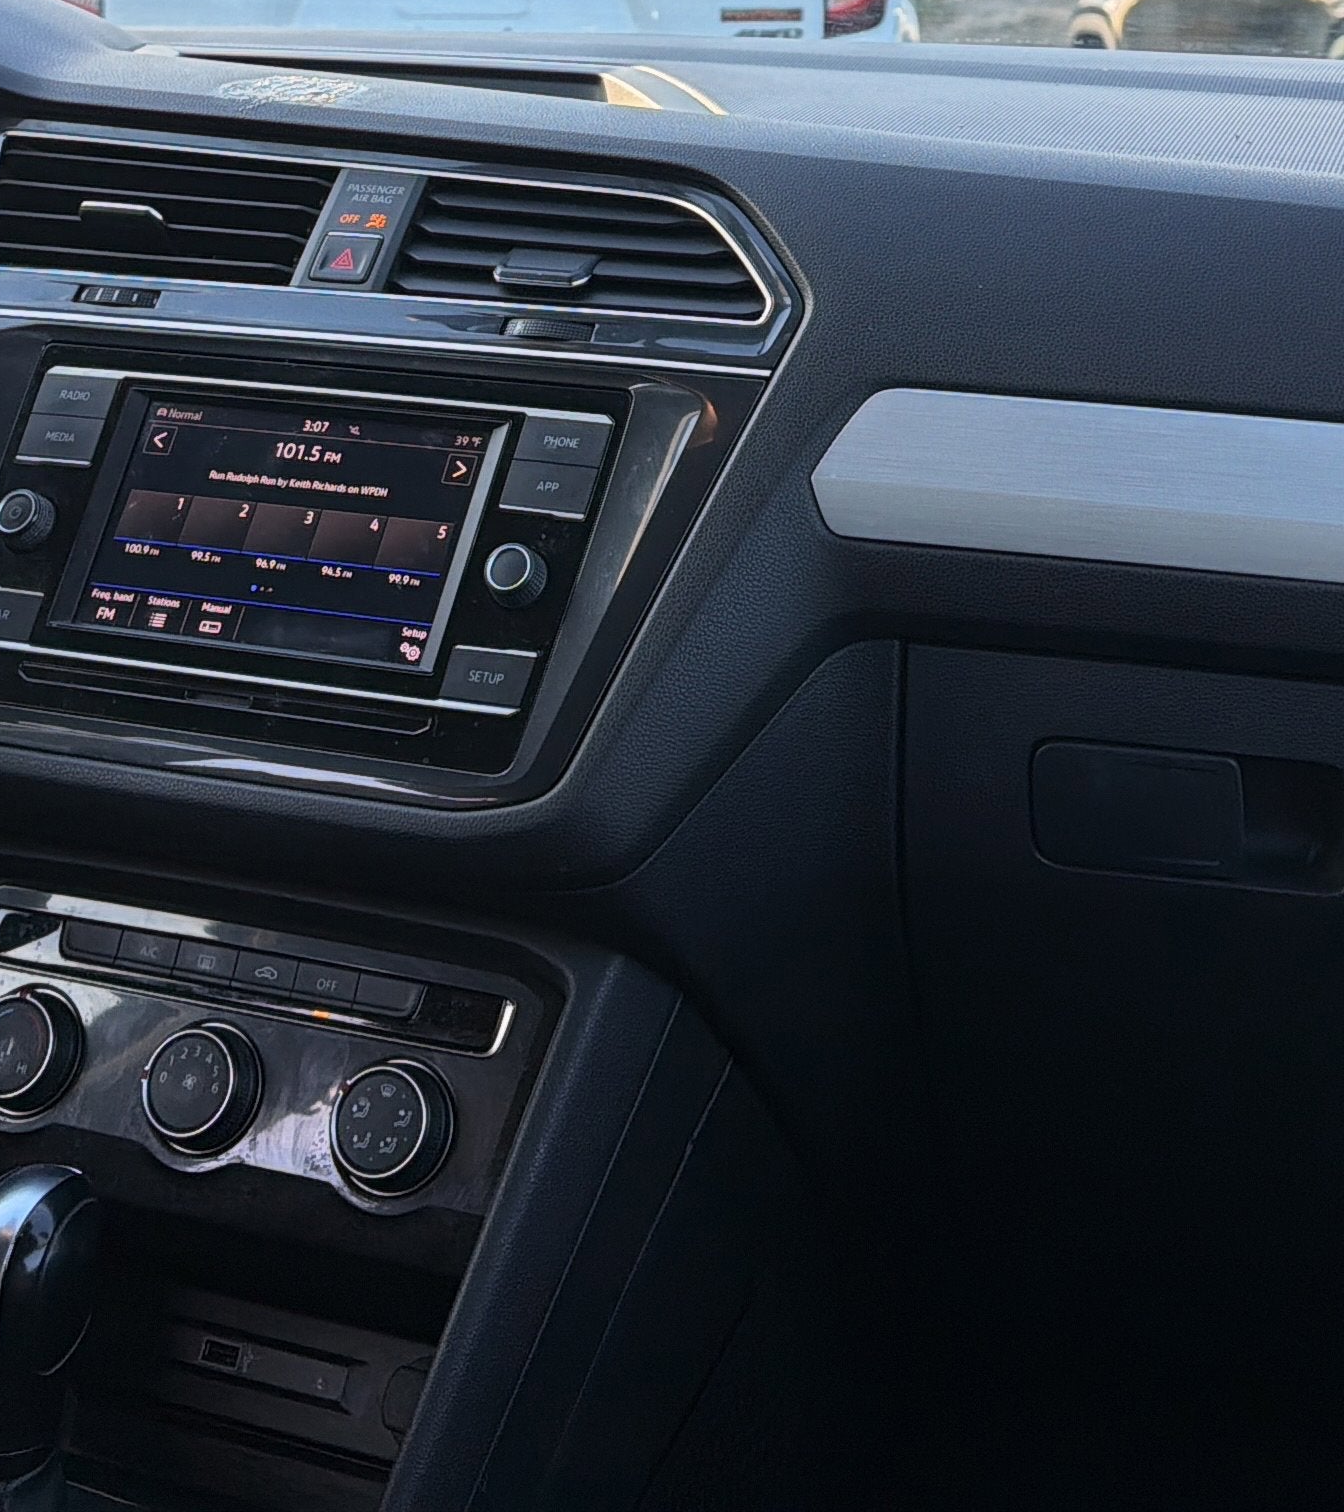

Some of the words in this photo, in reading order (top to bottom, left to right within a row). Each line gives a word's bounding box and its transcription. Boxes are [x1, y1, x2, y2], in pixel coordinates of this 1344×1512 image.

[347, 183, 406, 195] PASSENGER
[351, 193, 368, 203] AIR
[370, 194, 394, 205] BAG
[339, 213, 362, 225] OFF
[59, 389, 91, 402] RADIO
[168, 407, 204, 422] Normal
[302, 419, 331, 433] 3:07
[44, 430, 76, 443] MEDIA
[454, 435, 469, 447] 39
[543, 434, 580, 449] PHONE
[274, 441, 324, 462] 101.5
[323, 450, 342, 464] FM
[208, 470, 226, 481] Run
[226, 471, 259, 485] Rudolph
[260, 475, 277, 486] Run
[277, 477, 289, 489] by
[289, 478, 311, 490] Keith
[312, 481, 347, 494] Richards
[347, 485, 359, 494] on
[360, 486, 389, 498] WPDH
[536, 480, 560, 492] APP
[177, 497, 185, 510] 1
[239, 504, 250, 518] 2
[304, 511, 314, 525] 3
[369, 518, 380, 532] 4
[437, 525, 448, 540] 5
[124, 543, 149, 555] 100.9
[191, 551, 210, 563] 99.5
[388, 573, 410, 585] 99.9
[113, 591, 135, 603] band
[147, 596, 181, 609] Stations
[95, 606, 117, 621] FM
[201, 602, 233, 615] Manual
[401, 626, 428, 641] Setup
[467, 669, 505, 686] SETUP
[140, 945, 159, 957] A/C
[316, 977, 338, 992] OFF
[180, 1047, 189, 1059] 2
[193, 1045, 202, 1058] 3
[169, 1055, 176, 1067] 1
[205, 1052, 213, 1065] 4
[16, 1061, 28, 1075] HI
[212, 1065, 219, 1077] 5
[159, 1069, 168, 1084] 0
[211, 1081, 219, 1094] 6
